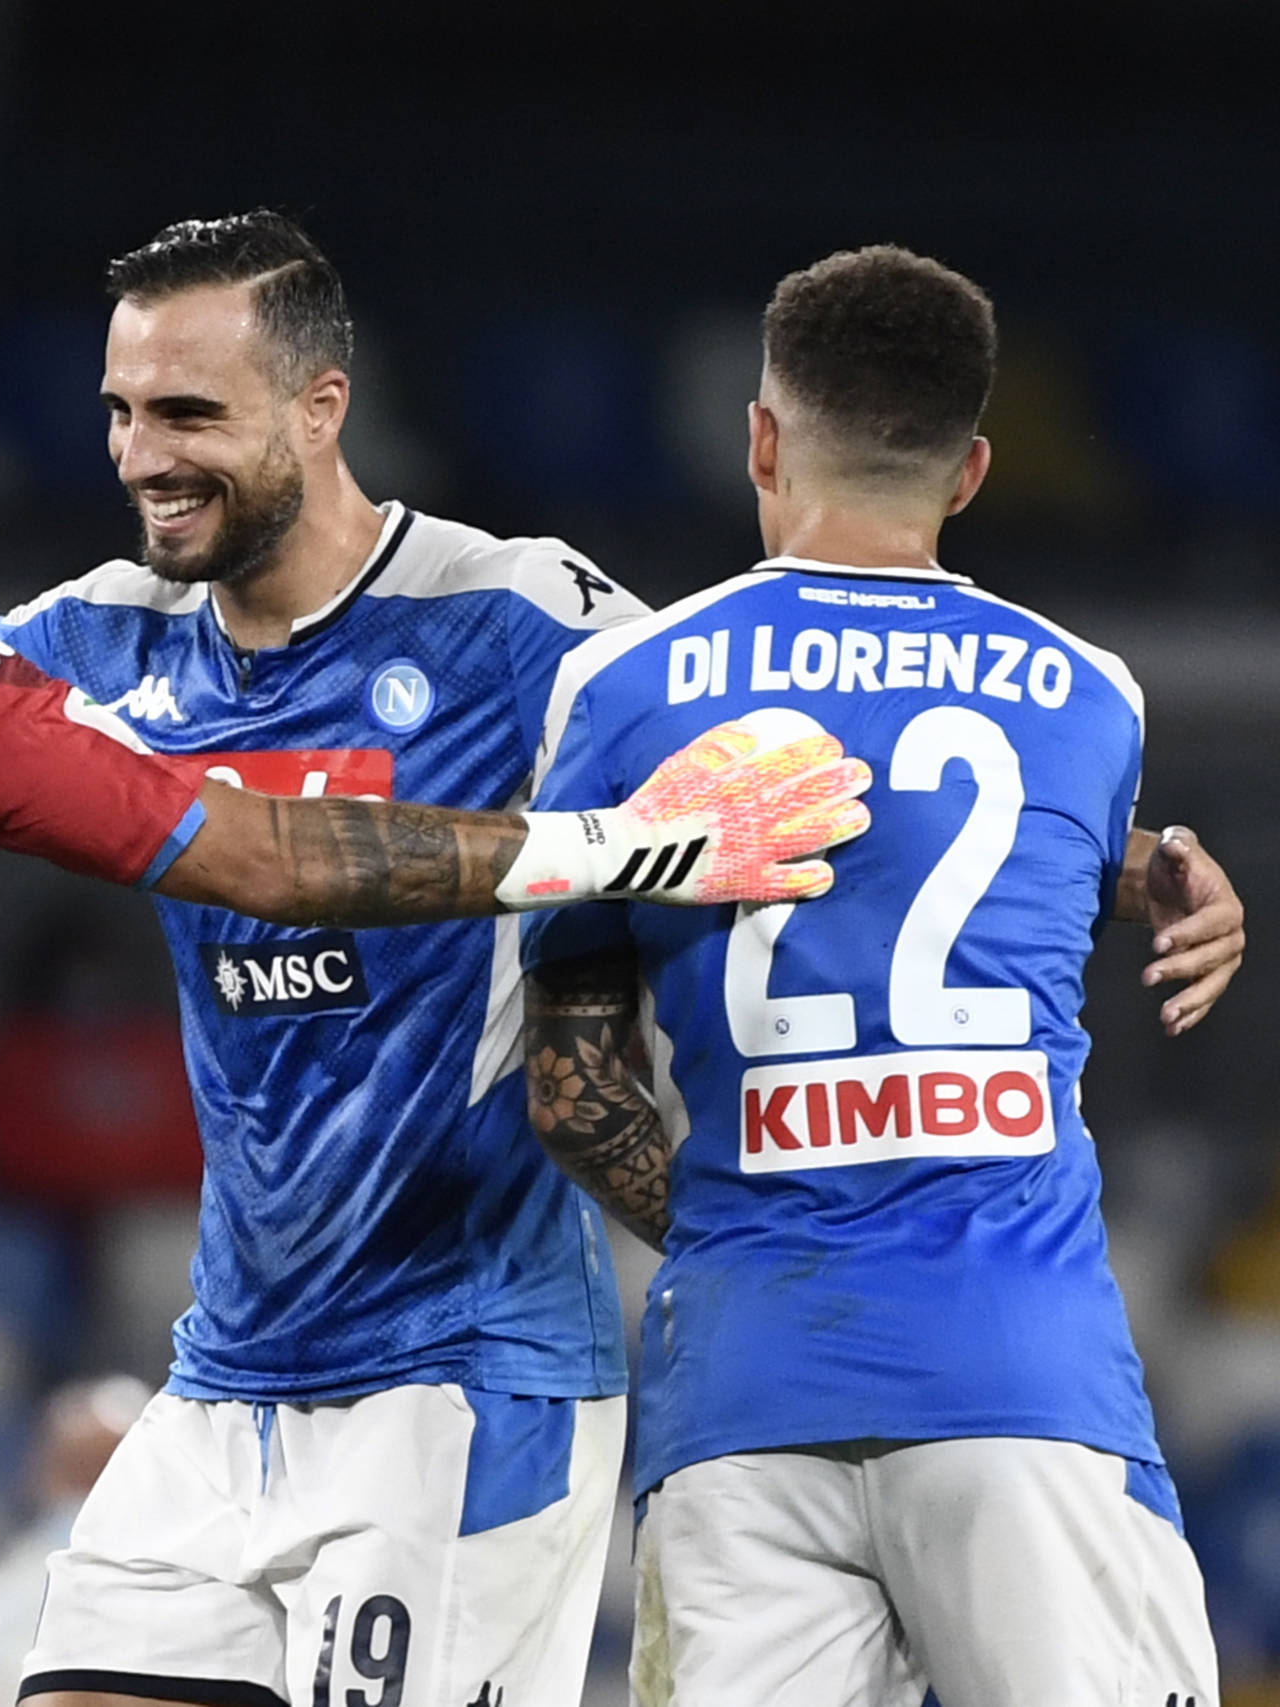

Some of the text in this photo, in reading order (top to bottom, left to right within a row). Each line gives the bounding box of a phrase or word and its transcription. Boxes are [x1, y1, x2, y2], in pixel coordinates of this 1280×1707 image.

[668, 625, 1072, 709] DI LORENZO
[243, 950, 353, 1002] MSC
[745, 1071, 1044, 1154] KIMBO
[312, 1594, 411, 1707] 19
